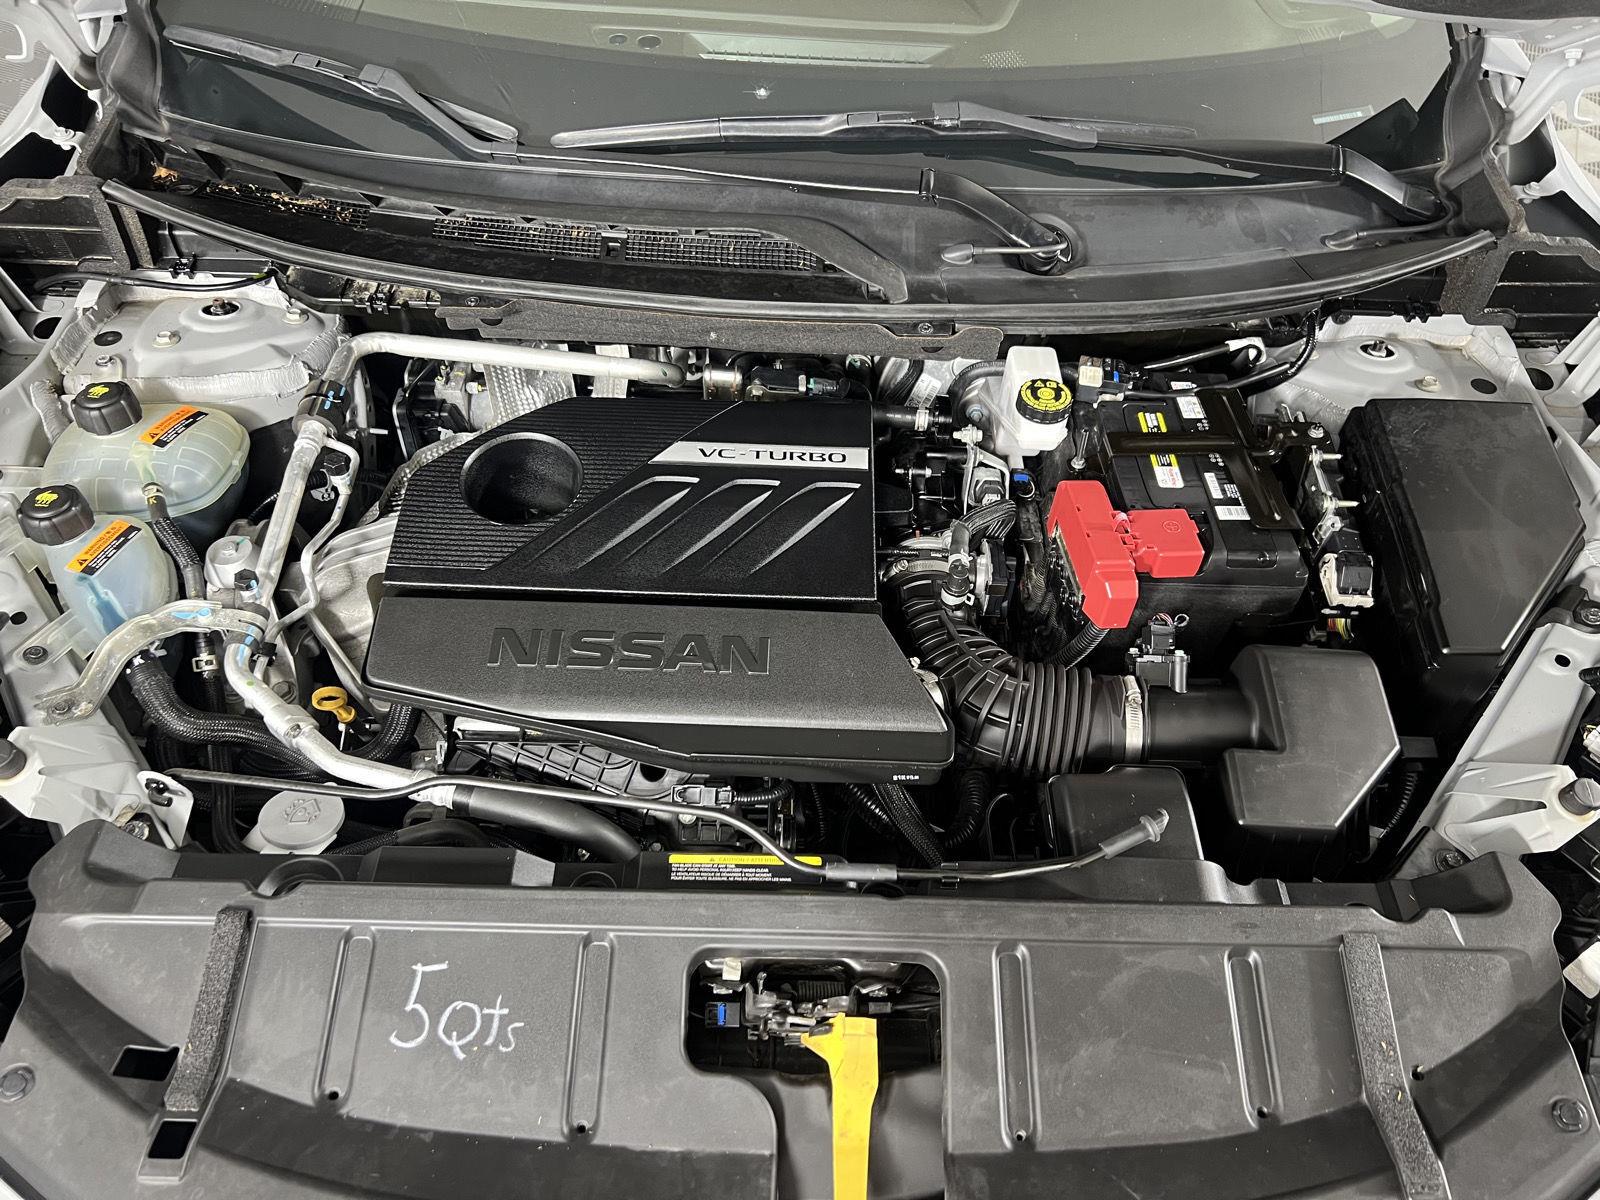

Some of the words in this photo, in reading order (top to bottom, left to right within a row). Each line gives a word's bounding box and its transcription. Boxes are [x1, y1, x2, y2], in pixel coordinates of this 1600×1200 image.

[698, 448, 847, 463] VC-TURBO
[487, 627, 770, 675] NISSAN
[389, 960, 449, 1048] 5
[437, 994, 525, 1060] Qts
